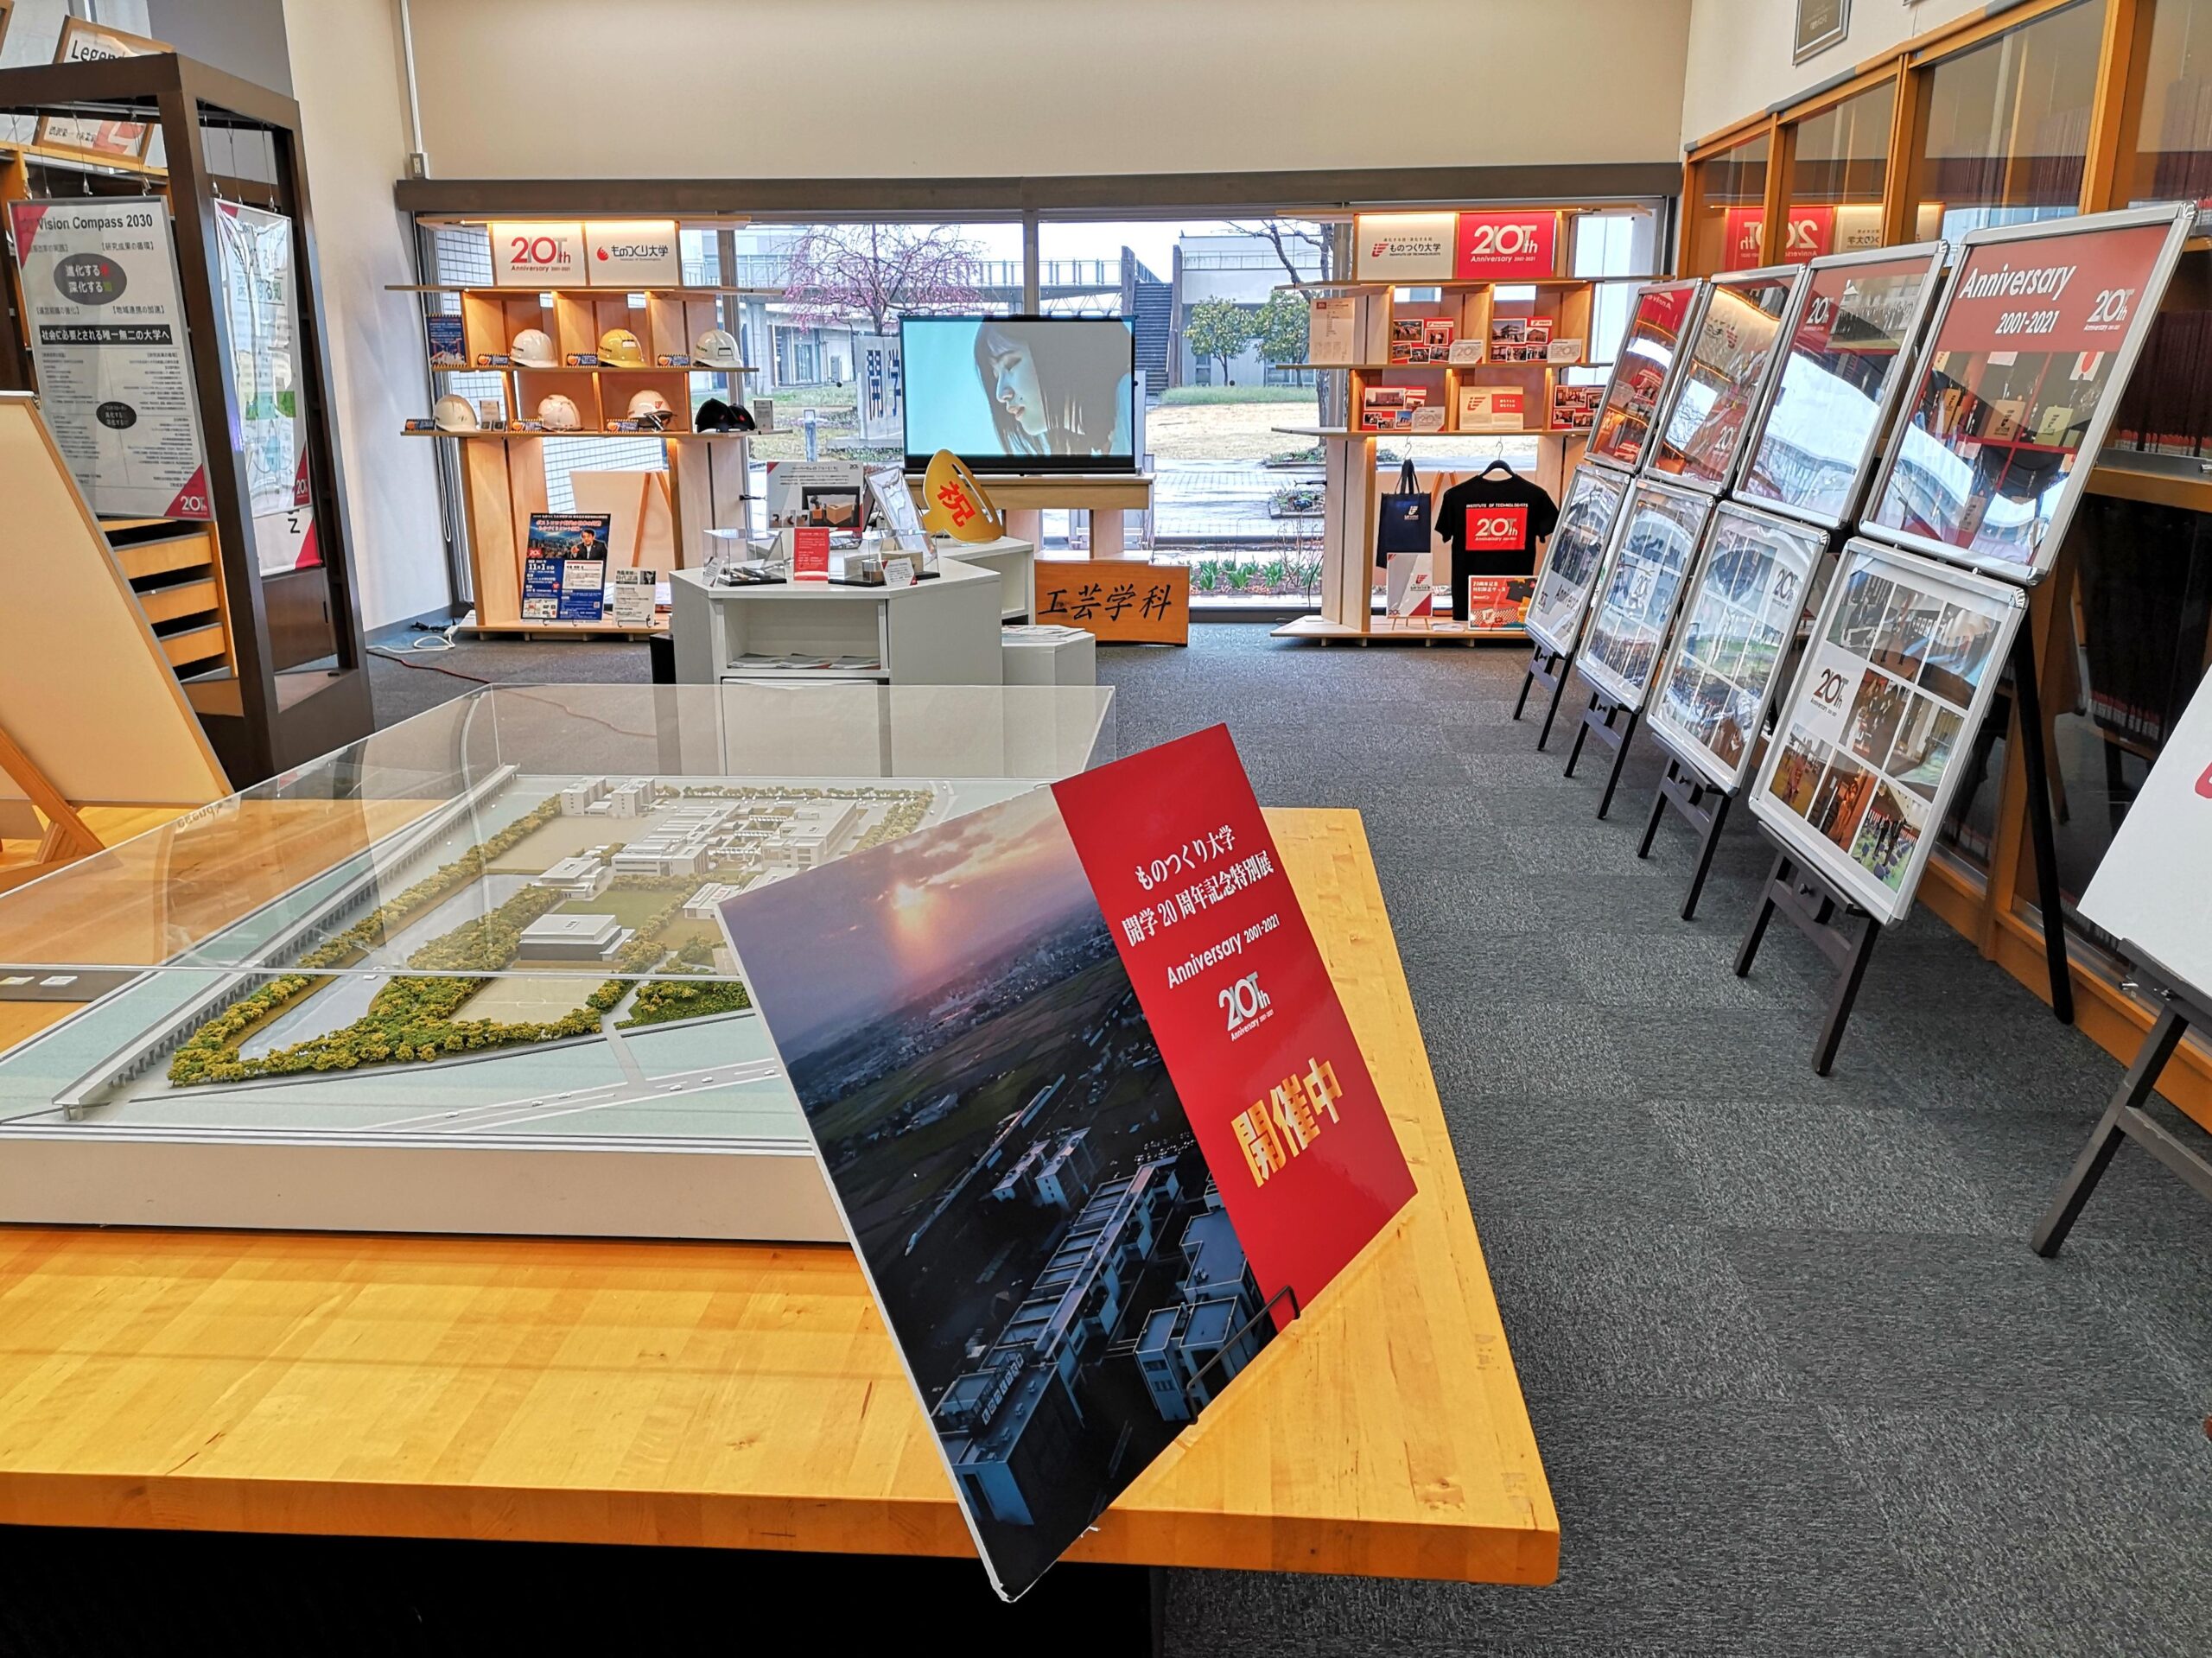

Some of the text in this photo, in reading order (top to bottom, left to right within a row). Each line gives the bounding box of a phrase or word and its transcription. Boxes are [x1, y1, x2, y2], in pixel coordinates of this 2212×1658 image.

[38, 218, 70, 230] Vision
[73, 216, 124, 231] Compass
[126, 214, 153, 227] 2030
[611, 245, 669, 257] ものつくり大学
[1389, 243, 1441, 252] ものつくり大学
[1959, 264, 2076, 302] Anniversary
[41, 328, 170, 341] 社会に必要とされる唯一無二の大学へ
[1995, 310, 2060, 334] 2001-2021
[937, 480, 977, 527] 祝
[1038, 582, 1173, 622] 工芸学科
[1135, 824, 1236, 891] ものつくり大学
[1167, 913, 1281, 989] Anniversary 2001-2021
[1230, 1018, 1261, 1042] Anniversary
[1230, 1057, 1344, 1188] 開催中
